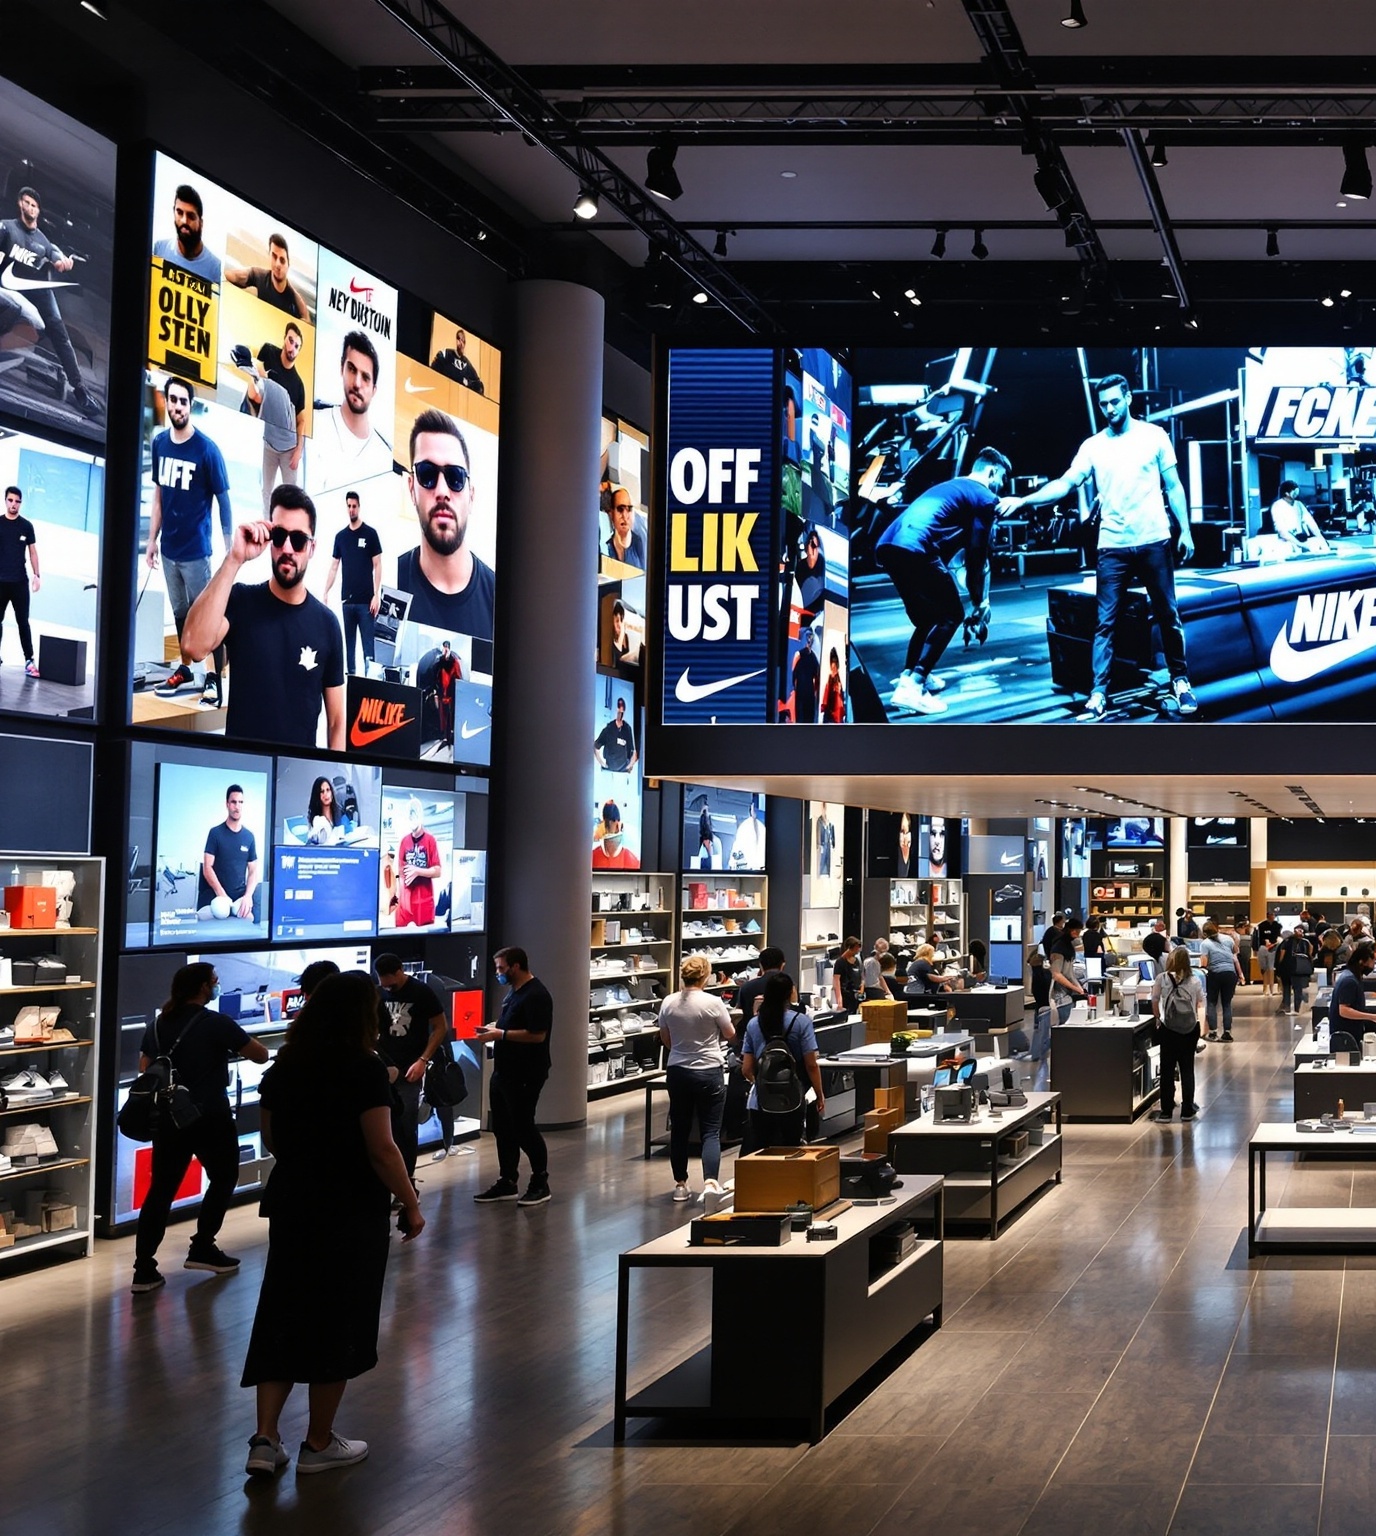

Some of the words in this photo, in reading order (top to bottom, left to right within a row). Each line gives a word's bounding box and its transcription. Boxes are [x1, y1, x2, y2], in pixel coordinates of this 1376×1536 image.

[158, 286, 211, 328] OLLY
[158, 315, 211, 358] STEN
[670, 447, 761, 505] OFF
[670, 512, 760, 572] LIK
[668, 584, 759, 641] UST
